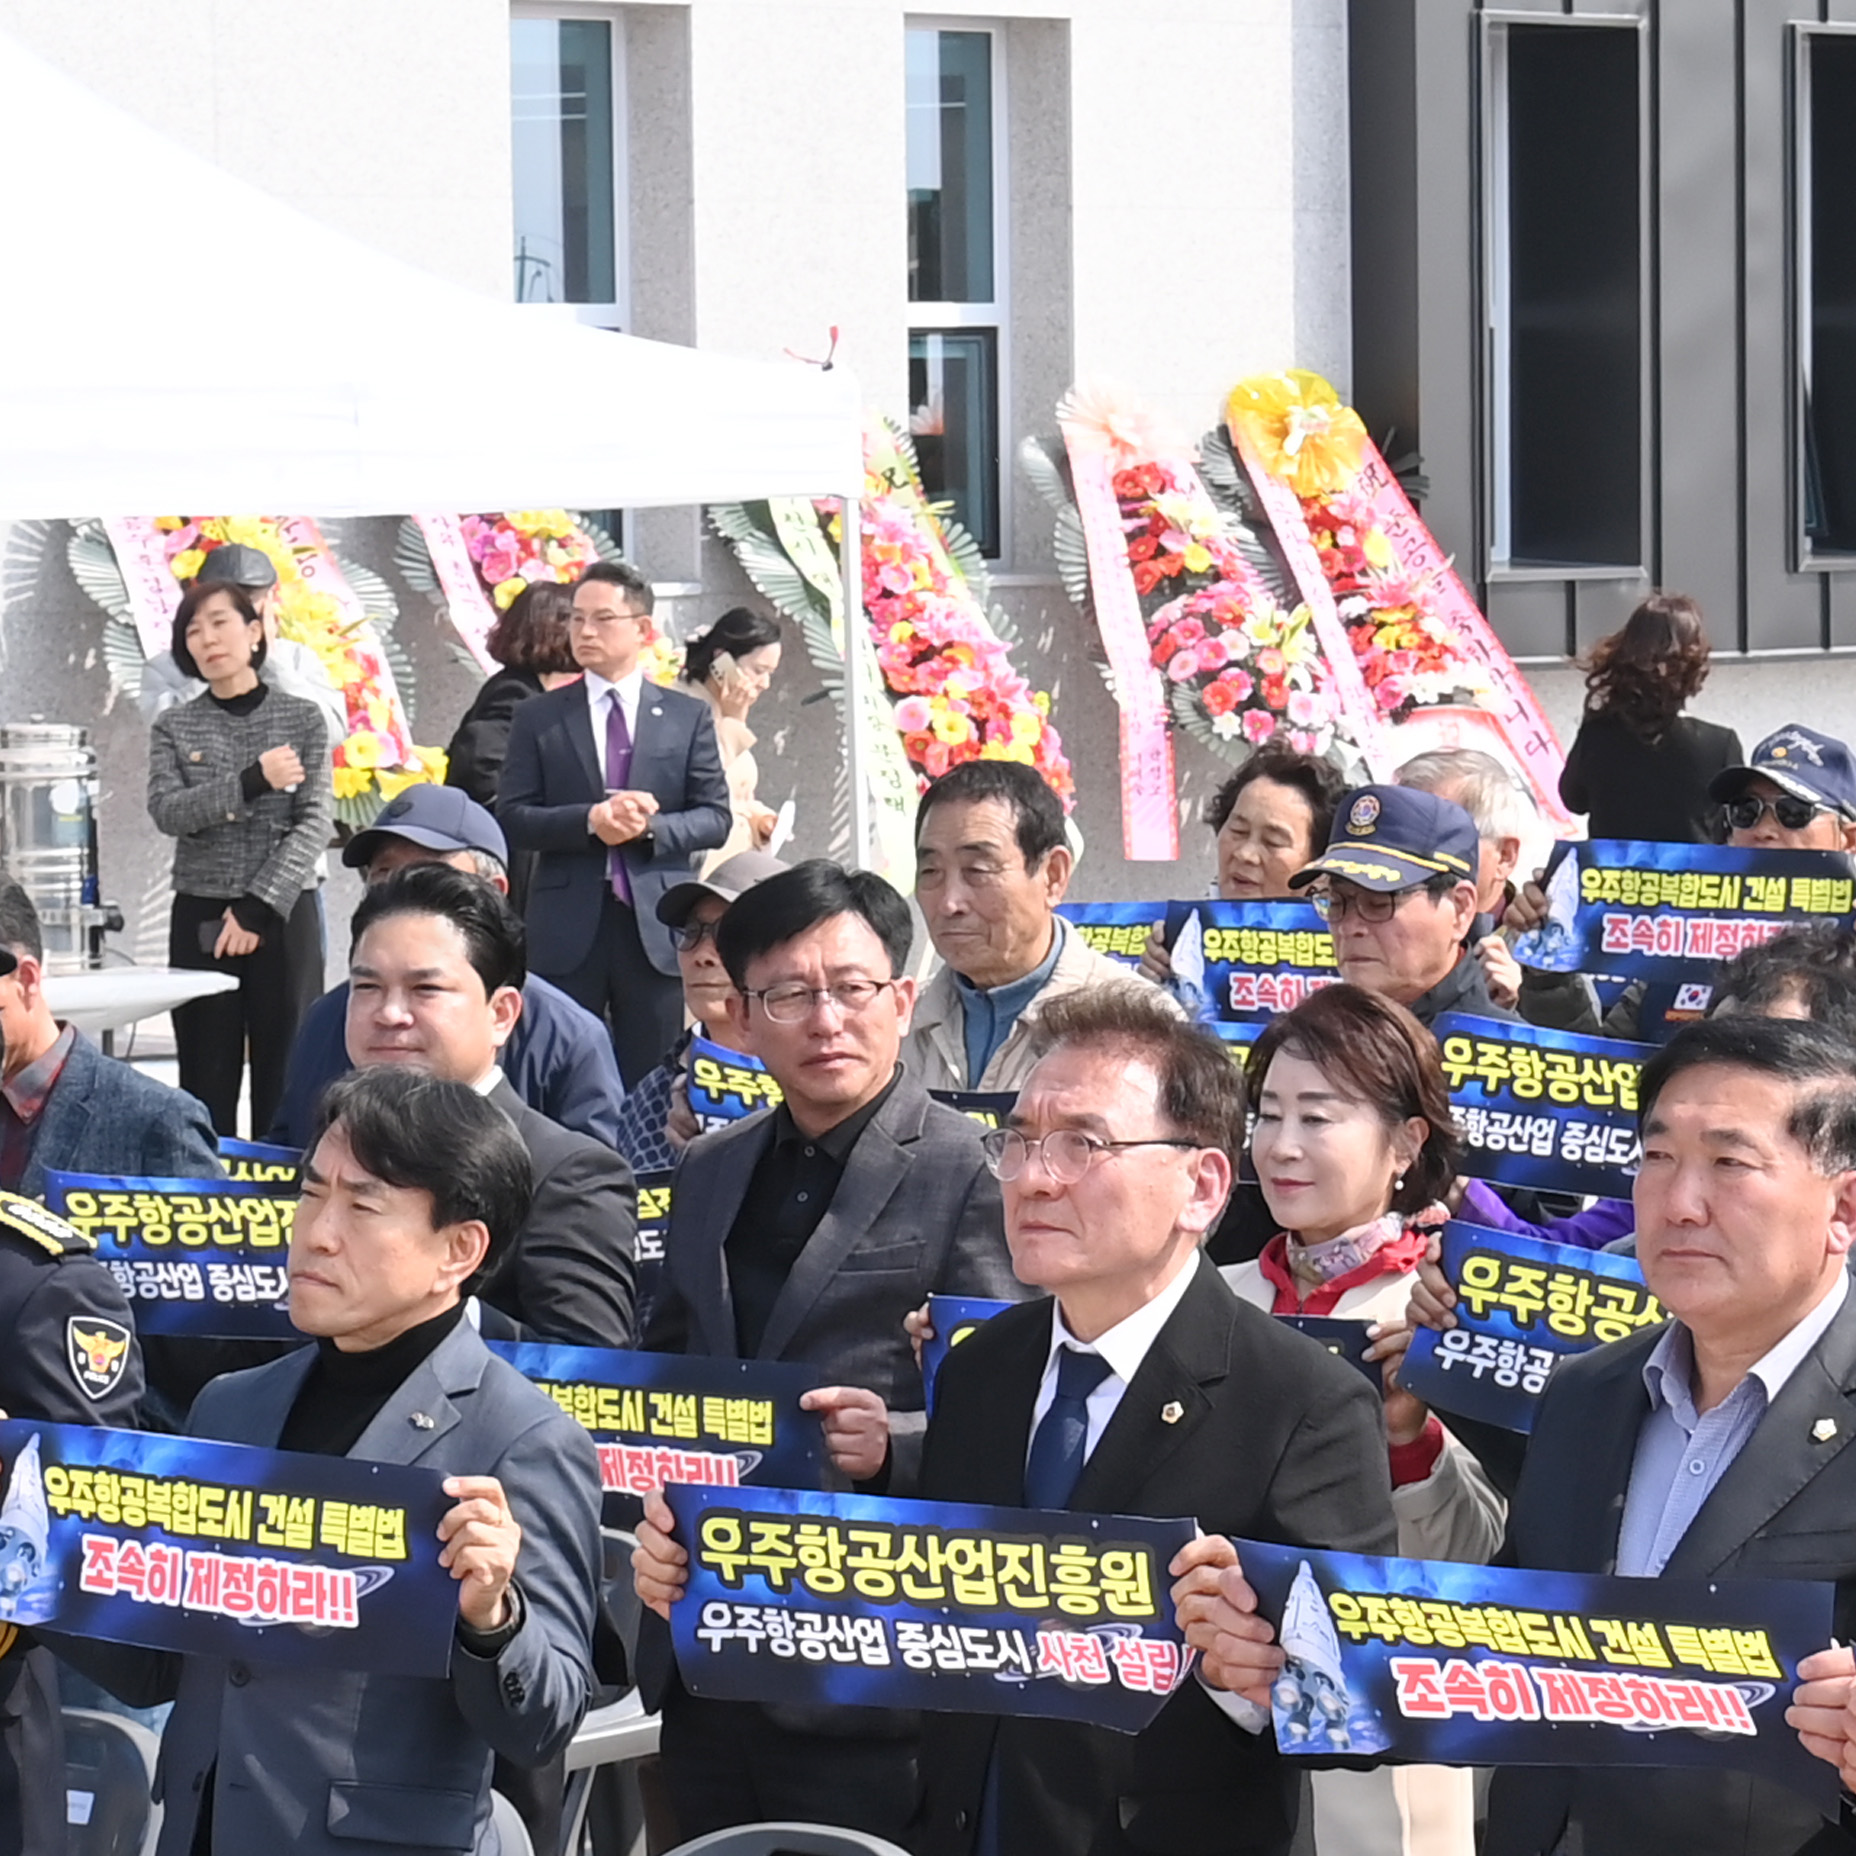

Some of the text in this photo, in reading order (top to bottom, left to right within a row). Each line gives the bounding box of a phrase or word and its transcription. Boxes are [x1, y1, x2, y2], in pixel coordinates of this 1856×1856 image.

[1581, 868, 1853, 913] 우주항공복합도시 건설 특별법
[1603, 913, 1683, 957] 조속히
[1230, 972, 1304, 1011] 조속히
[649, 1392, 699, 1439] 건설
[702, 1396, 773, 1446] 특별법
[44, 1464, 408, 1561] 우주항공복합도시 건설 특별법
[79, 1532, 361, 1629] 조속히 제정하라!!
[699, 1516, 1156, 1617] 우주항공산업진흥원
[696, 1605, 889, 1667] 우주항공산업
[896, 1622, 1031, 1676] 중심도시
[1035, 1630, 1111, 1685] 사천
[1327, 1591, 1783, 1680] 우주항공복합도시 건설 특별법
[1391, 1655, 1758, 1737] 조속히 제정하라!!
